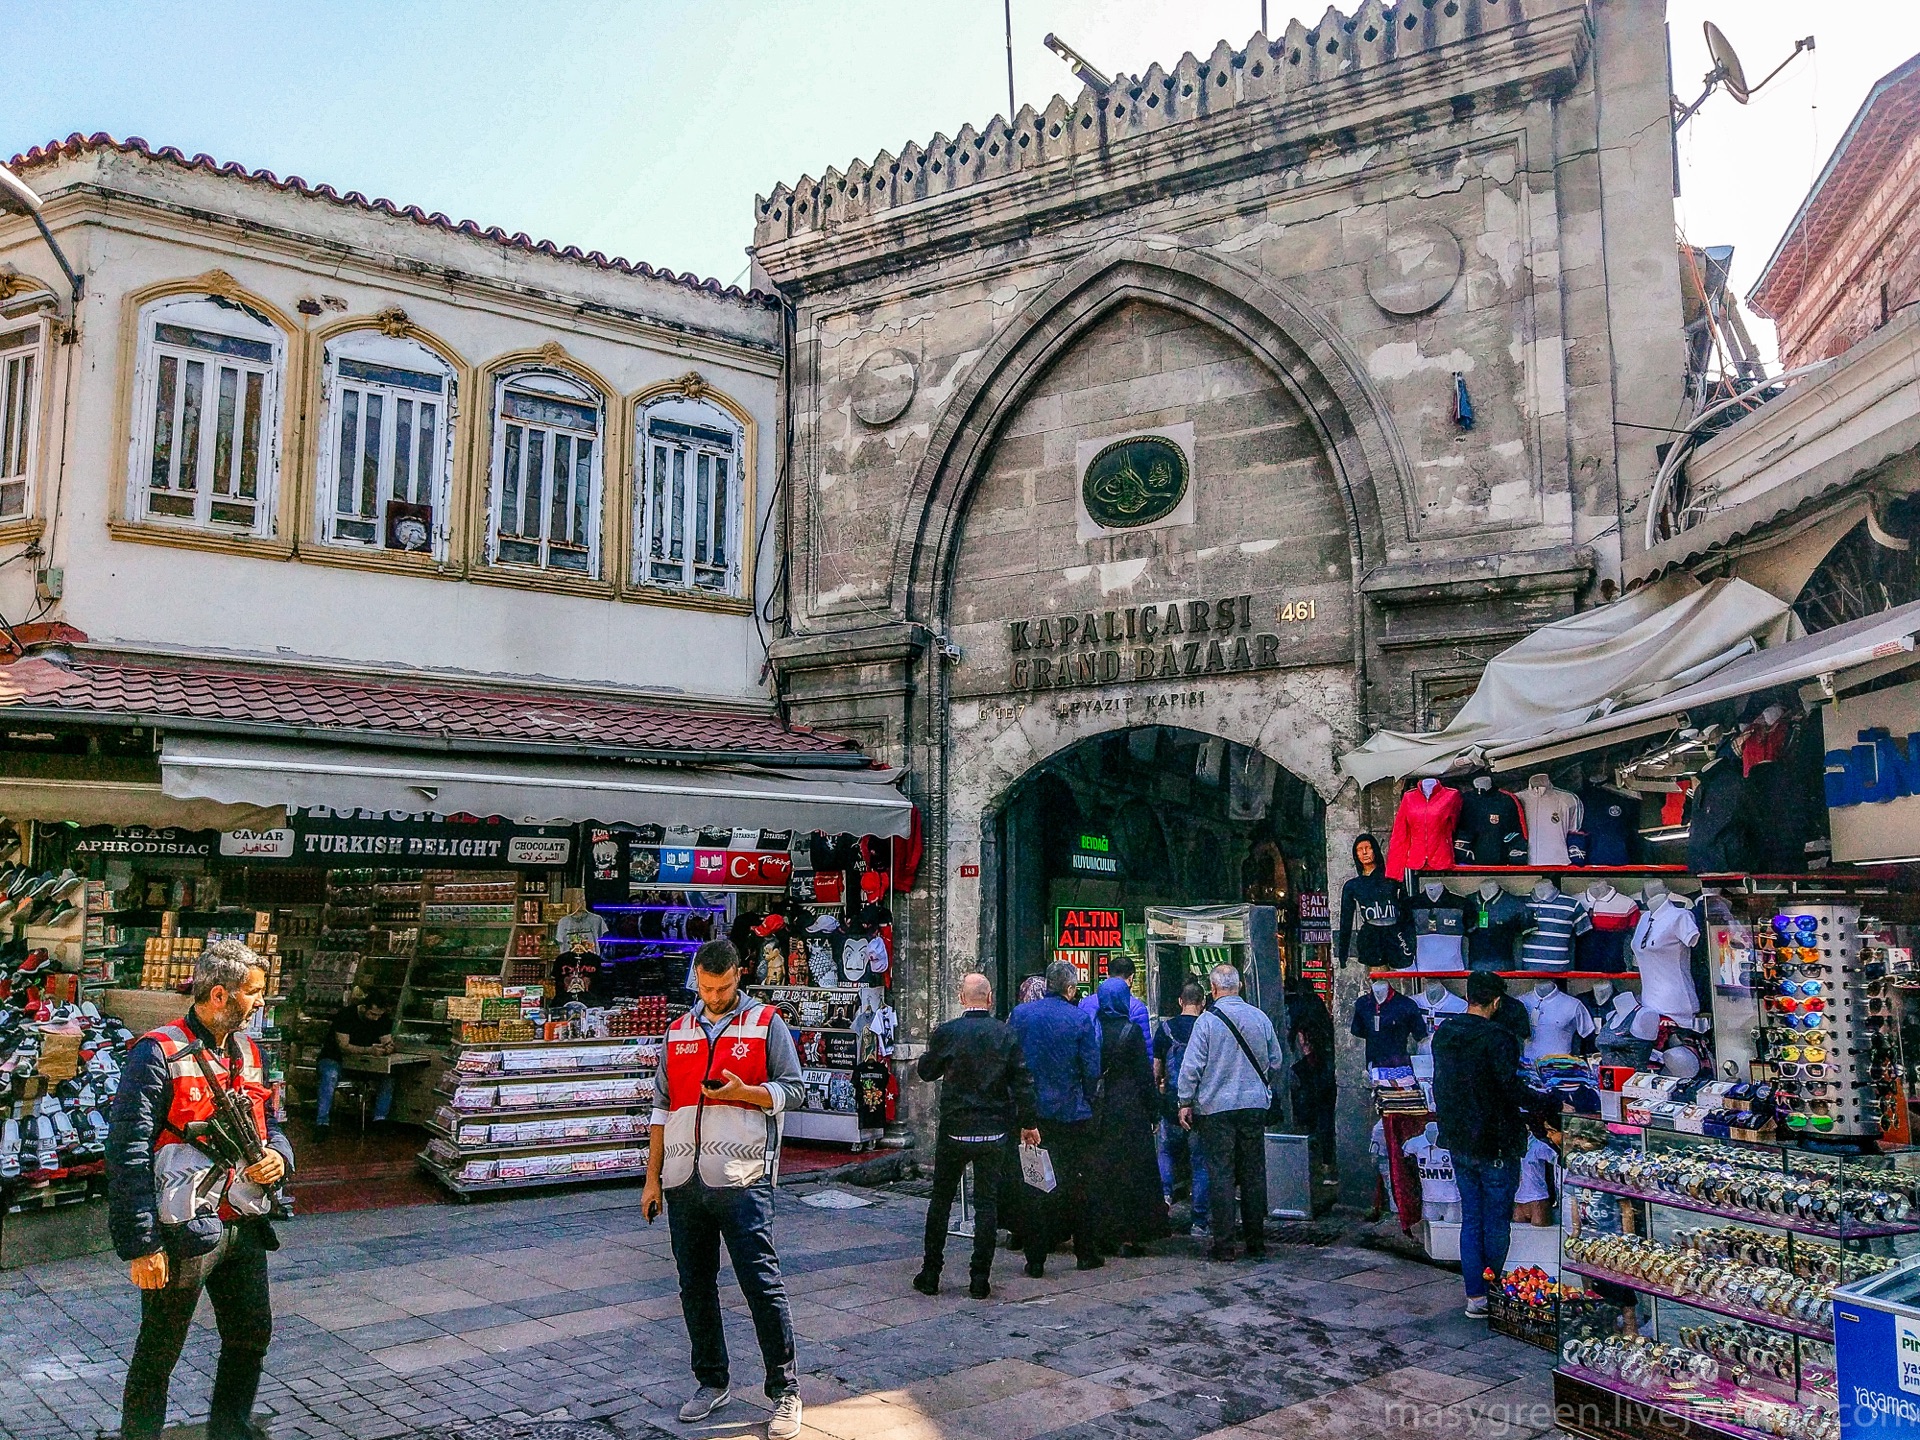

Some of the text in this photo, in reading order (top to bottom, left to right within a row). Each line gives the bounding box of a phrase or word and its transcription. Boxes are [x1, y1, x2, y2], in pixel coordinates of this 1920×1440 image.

[1010, 595, 1252, 652] KAPALIÇARŞI
[1010, 632, 1281, 690] GRAND BAZAAR
[232, 830, 284, 841] CAVIAR
[76, 841, 209, 855] APHRODISIAC
[304, 833, 501, 857] TURKISH DELIGHT
[514, 841, 566, 852] CHOCOLATE
[1065, 911, 1118, 927] ALTIN
[1059, 930, 1122, 947] ALINIR
[806, 1071, 827, 1082] ARMY
[1419, 1168, 1453, 1180] BMW
